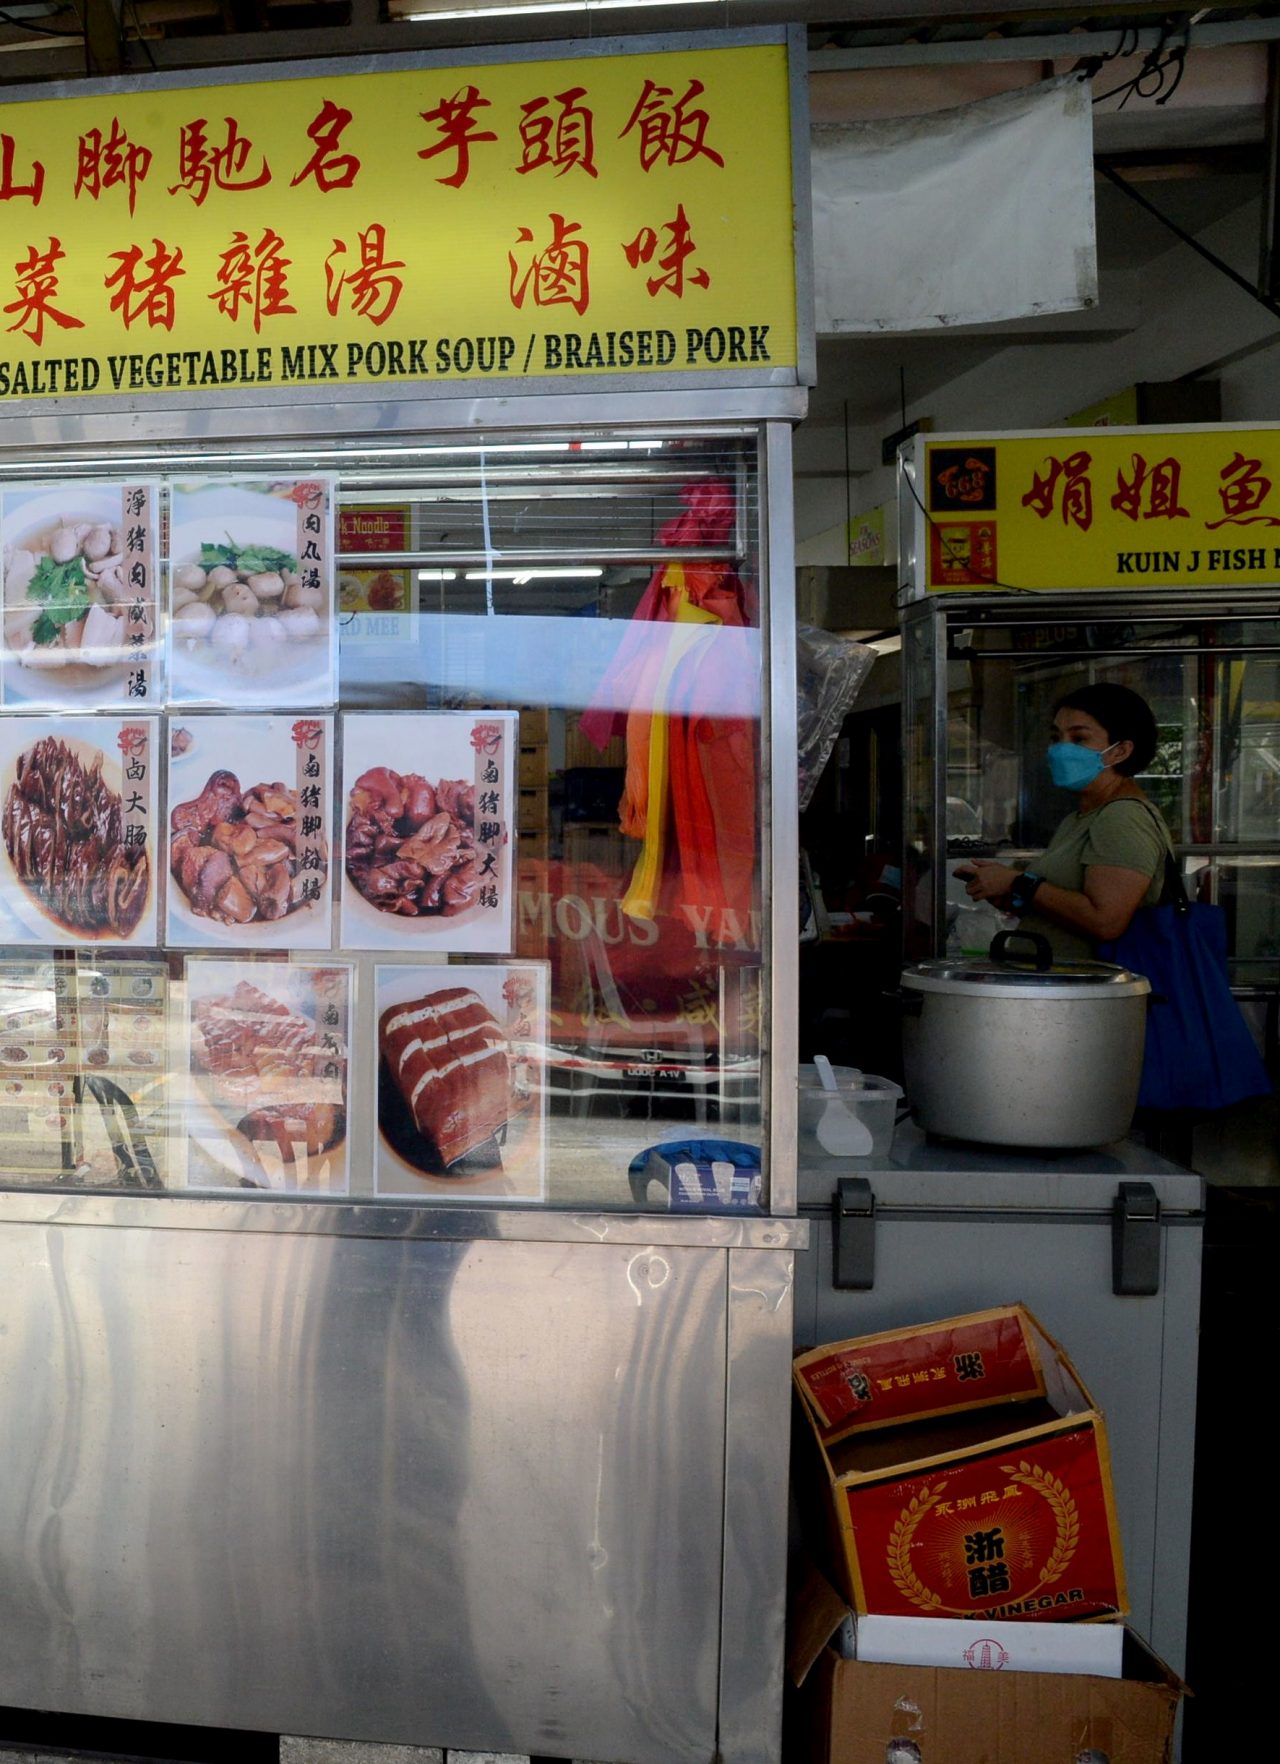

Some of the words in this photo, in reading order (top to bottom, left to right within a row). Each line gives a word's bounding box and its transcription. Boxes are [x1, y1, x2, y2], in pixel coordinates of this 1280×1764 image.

[509, 204, 710, 316] 滷味
[107, 346, 272, 389] VEGETABLE
[281, 343, 338, 380] MIX
[347, 339, 428, 377] PORK
[435, 336, 516, 374] SOUP
[523, 333, 535, 373] /
[543, 328, 677, 369] BRAISED
[686, 325, 770, 363] PORK
[945, 471, 986, 498] 668
[353, 515, 390, 535] Noodle
[1116, 551, 1180, 573] KUIN
[1187, 550, 1200, 572] J
[1208, 549, 1266, 571] FISH
[518, 890, 660, 947] MOUS
[963, 1527, 1012, 1602] 浙醋
[983, 1588, 1085, 1620] VINEGAR
